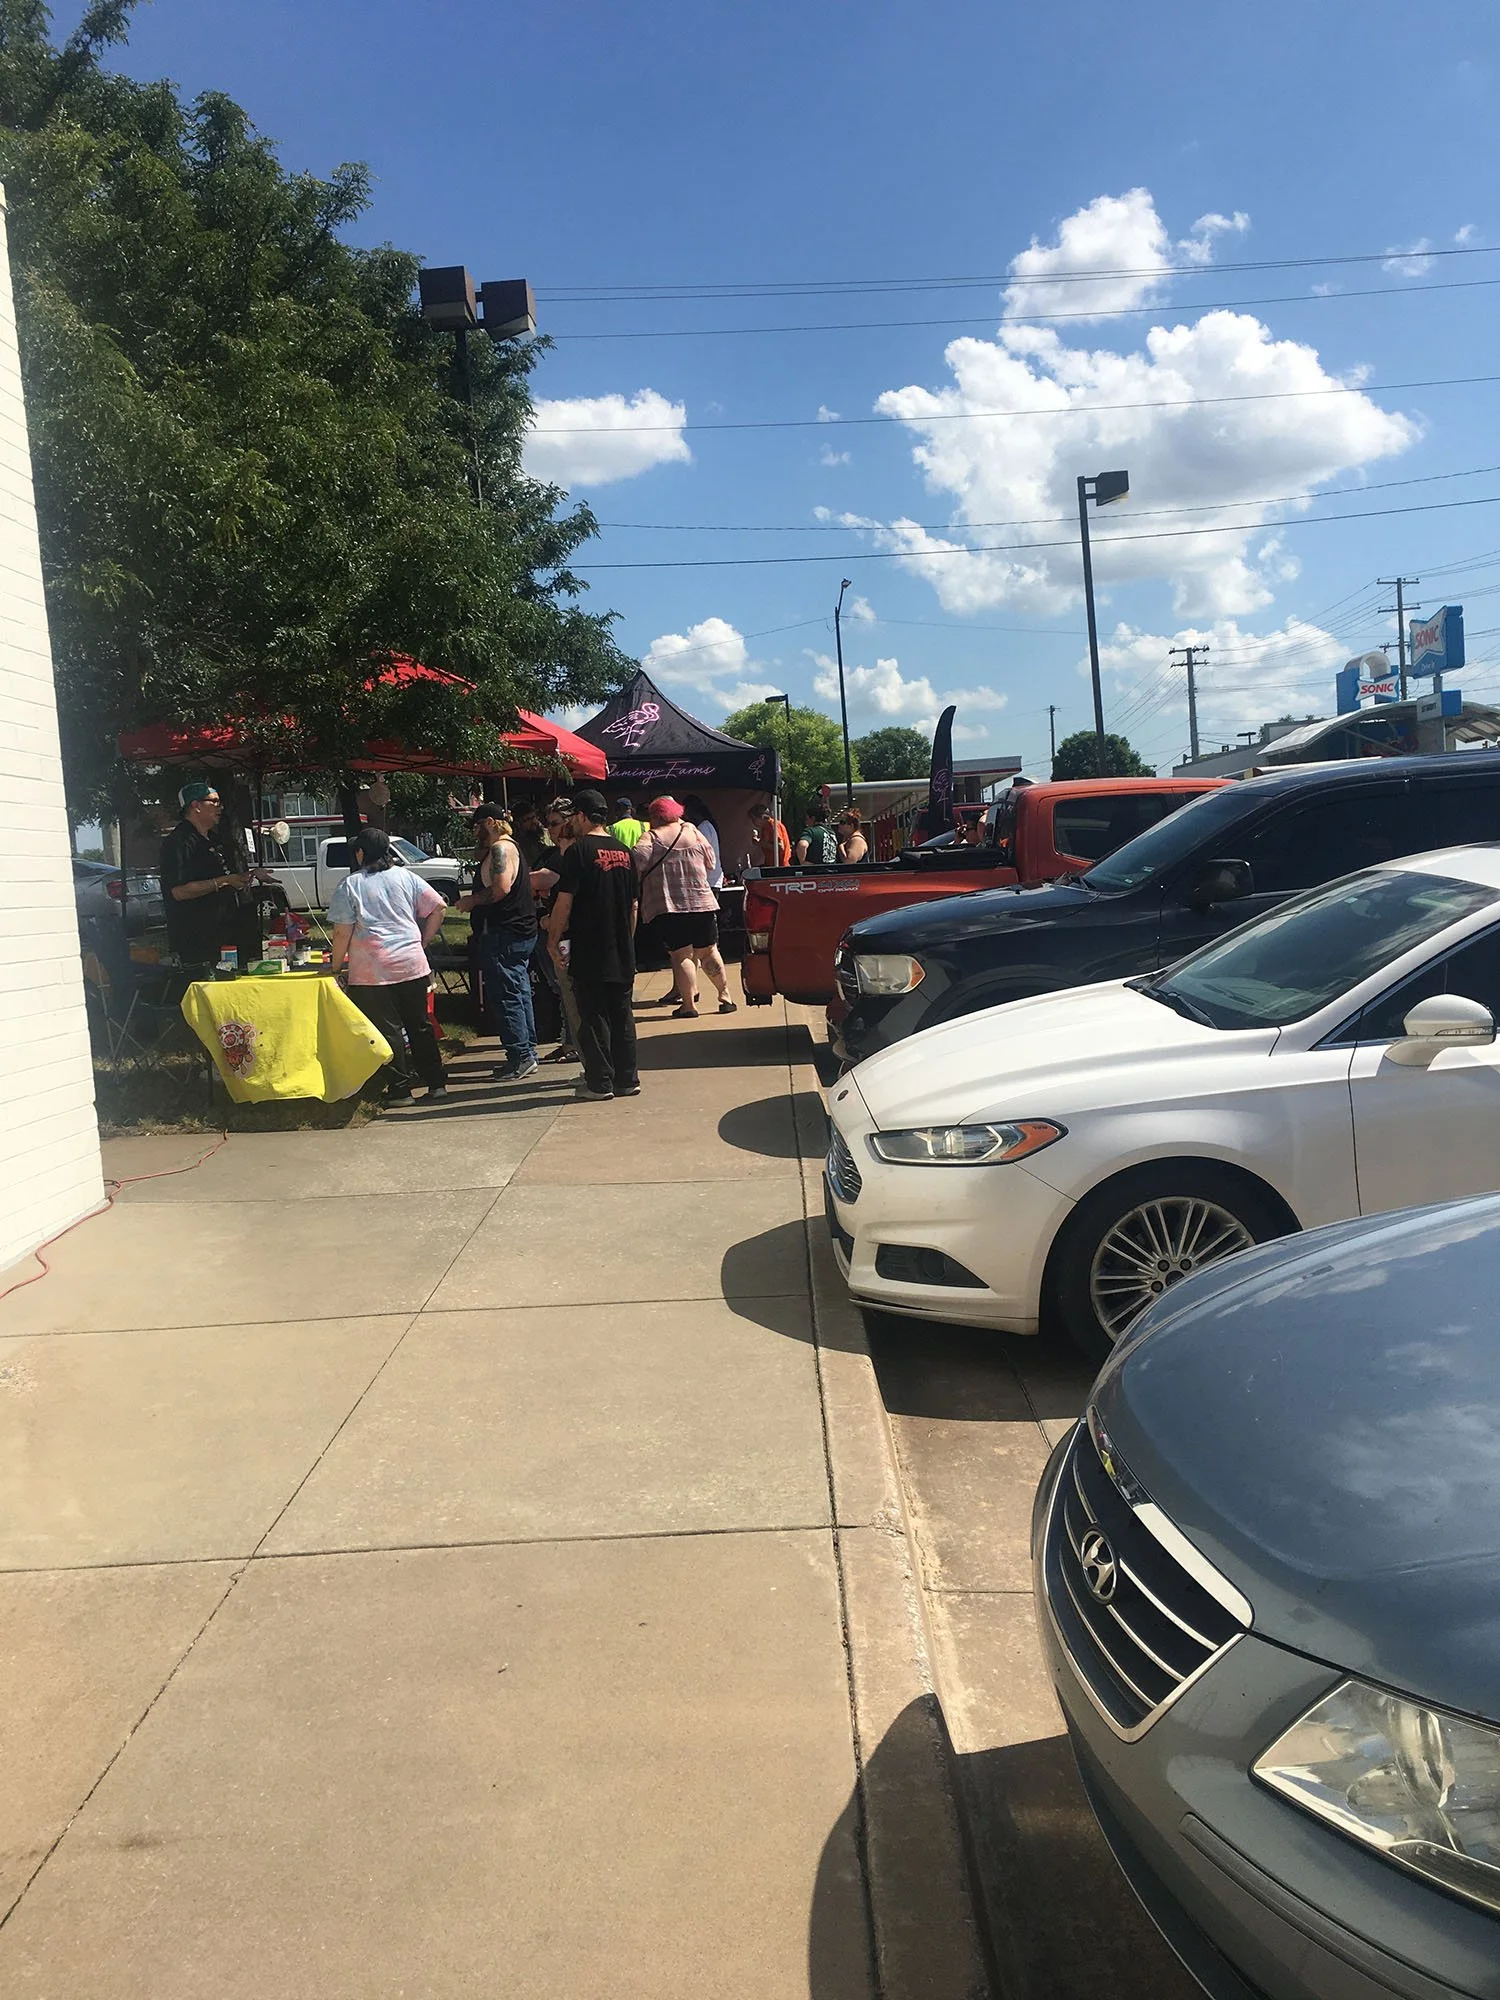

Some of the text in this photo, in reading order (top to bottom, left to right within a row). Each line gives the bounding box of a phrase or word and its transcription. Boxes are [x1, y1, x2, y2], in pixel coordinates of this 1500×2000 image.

[1415, 625, 1439, 649] SONIC
[1360, 682, 1394, 695] SONIC
[665, 760, 716, 779] Farms
[597, 849, 630, 862] COBRA
[769, 881, 817, 894] TRD
